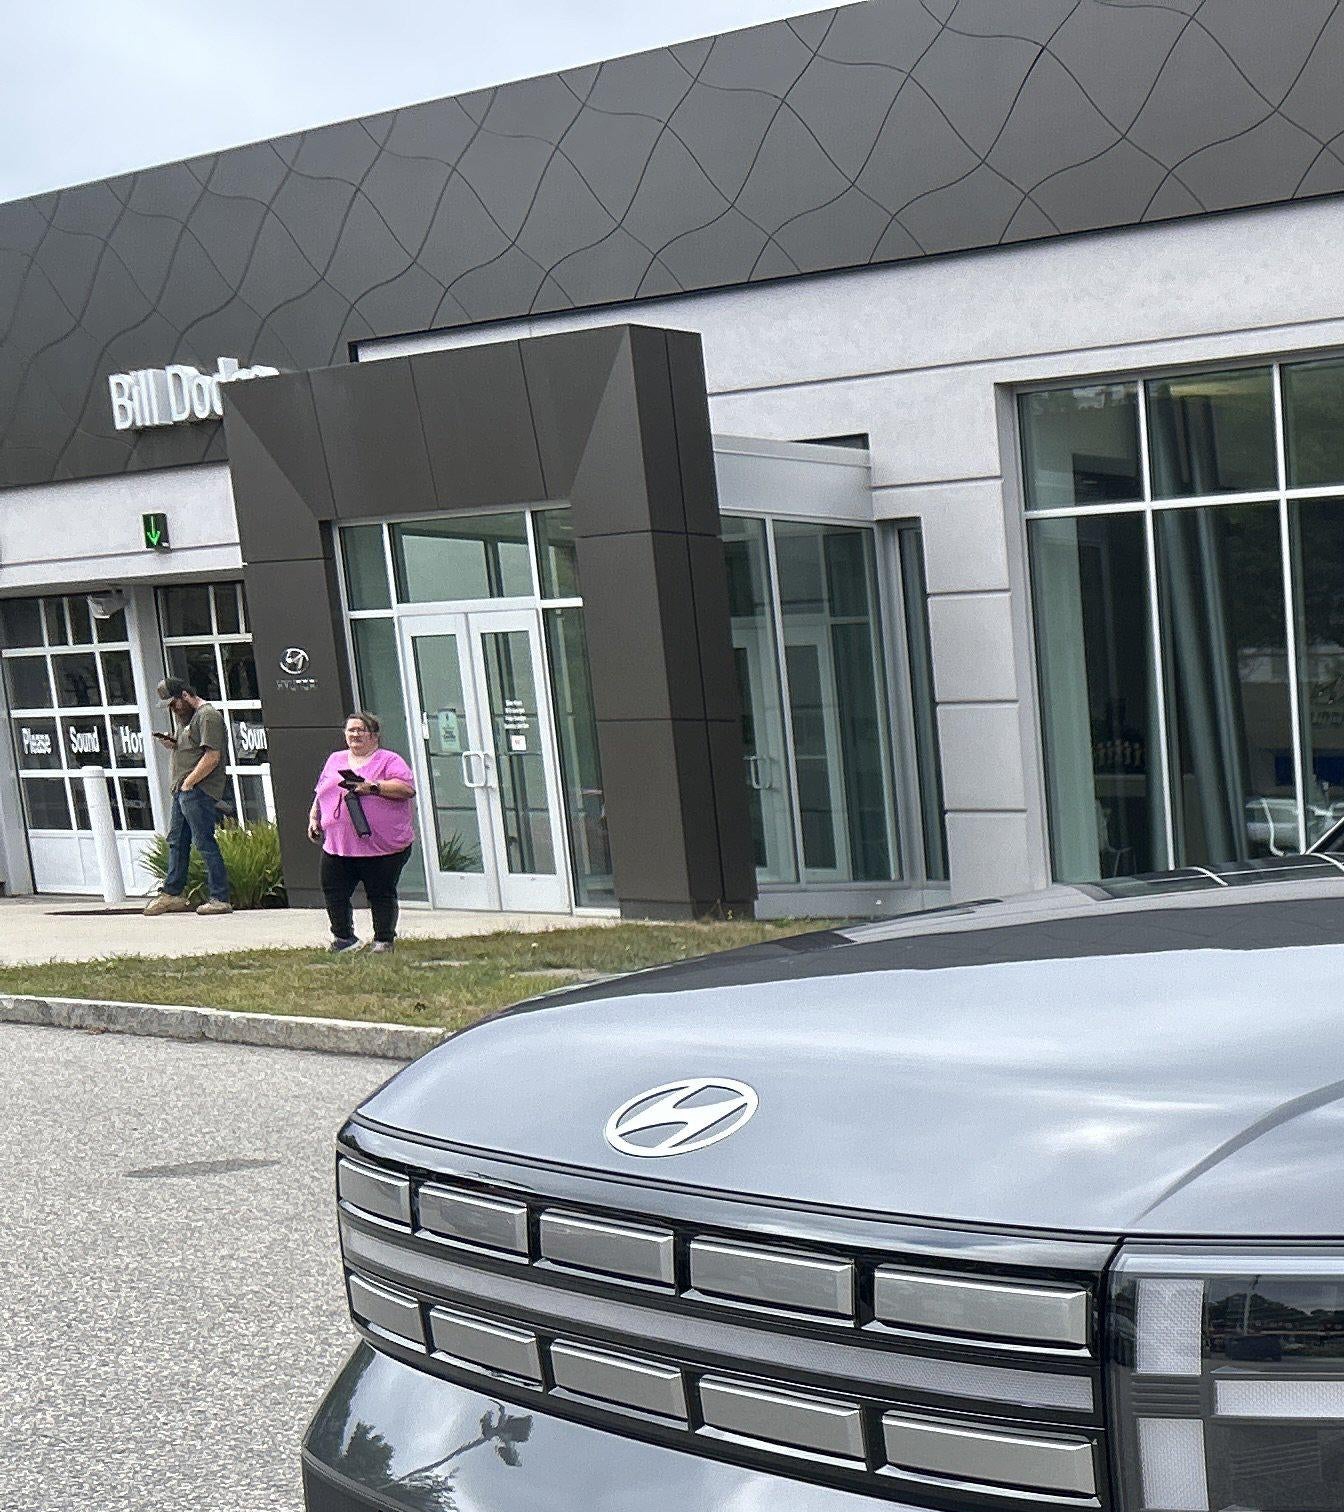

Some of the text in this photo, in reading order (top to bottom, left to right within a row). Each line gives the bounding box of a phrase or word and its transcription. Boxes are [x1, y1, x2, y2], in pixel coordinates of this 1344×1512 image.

[109, 369, 166, 430] Bill
[69, 725, 100, 753] Sound
[120, 725, 143, 753] Hor
[240, 721, 267, 750] Soun
